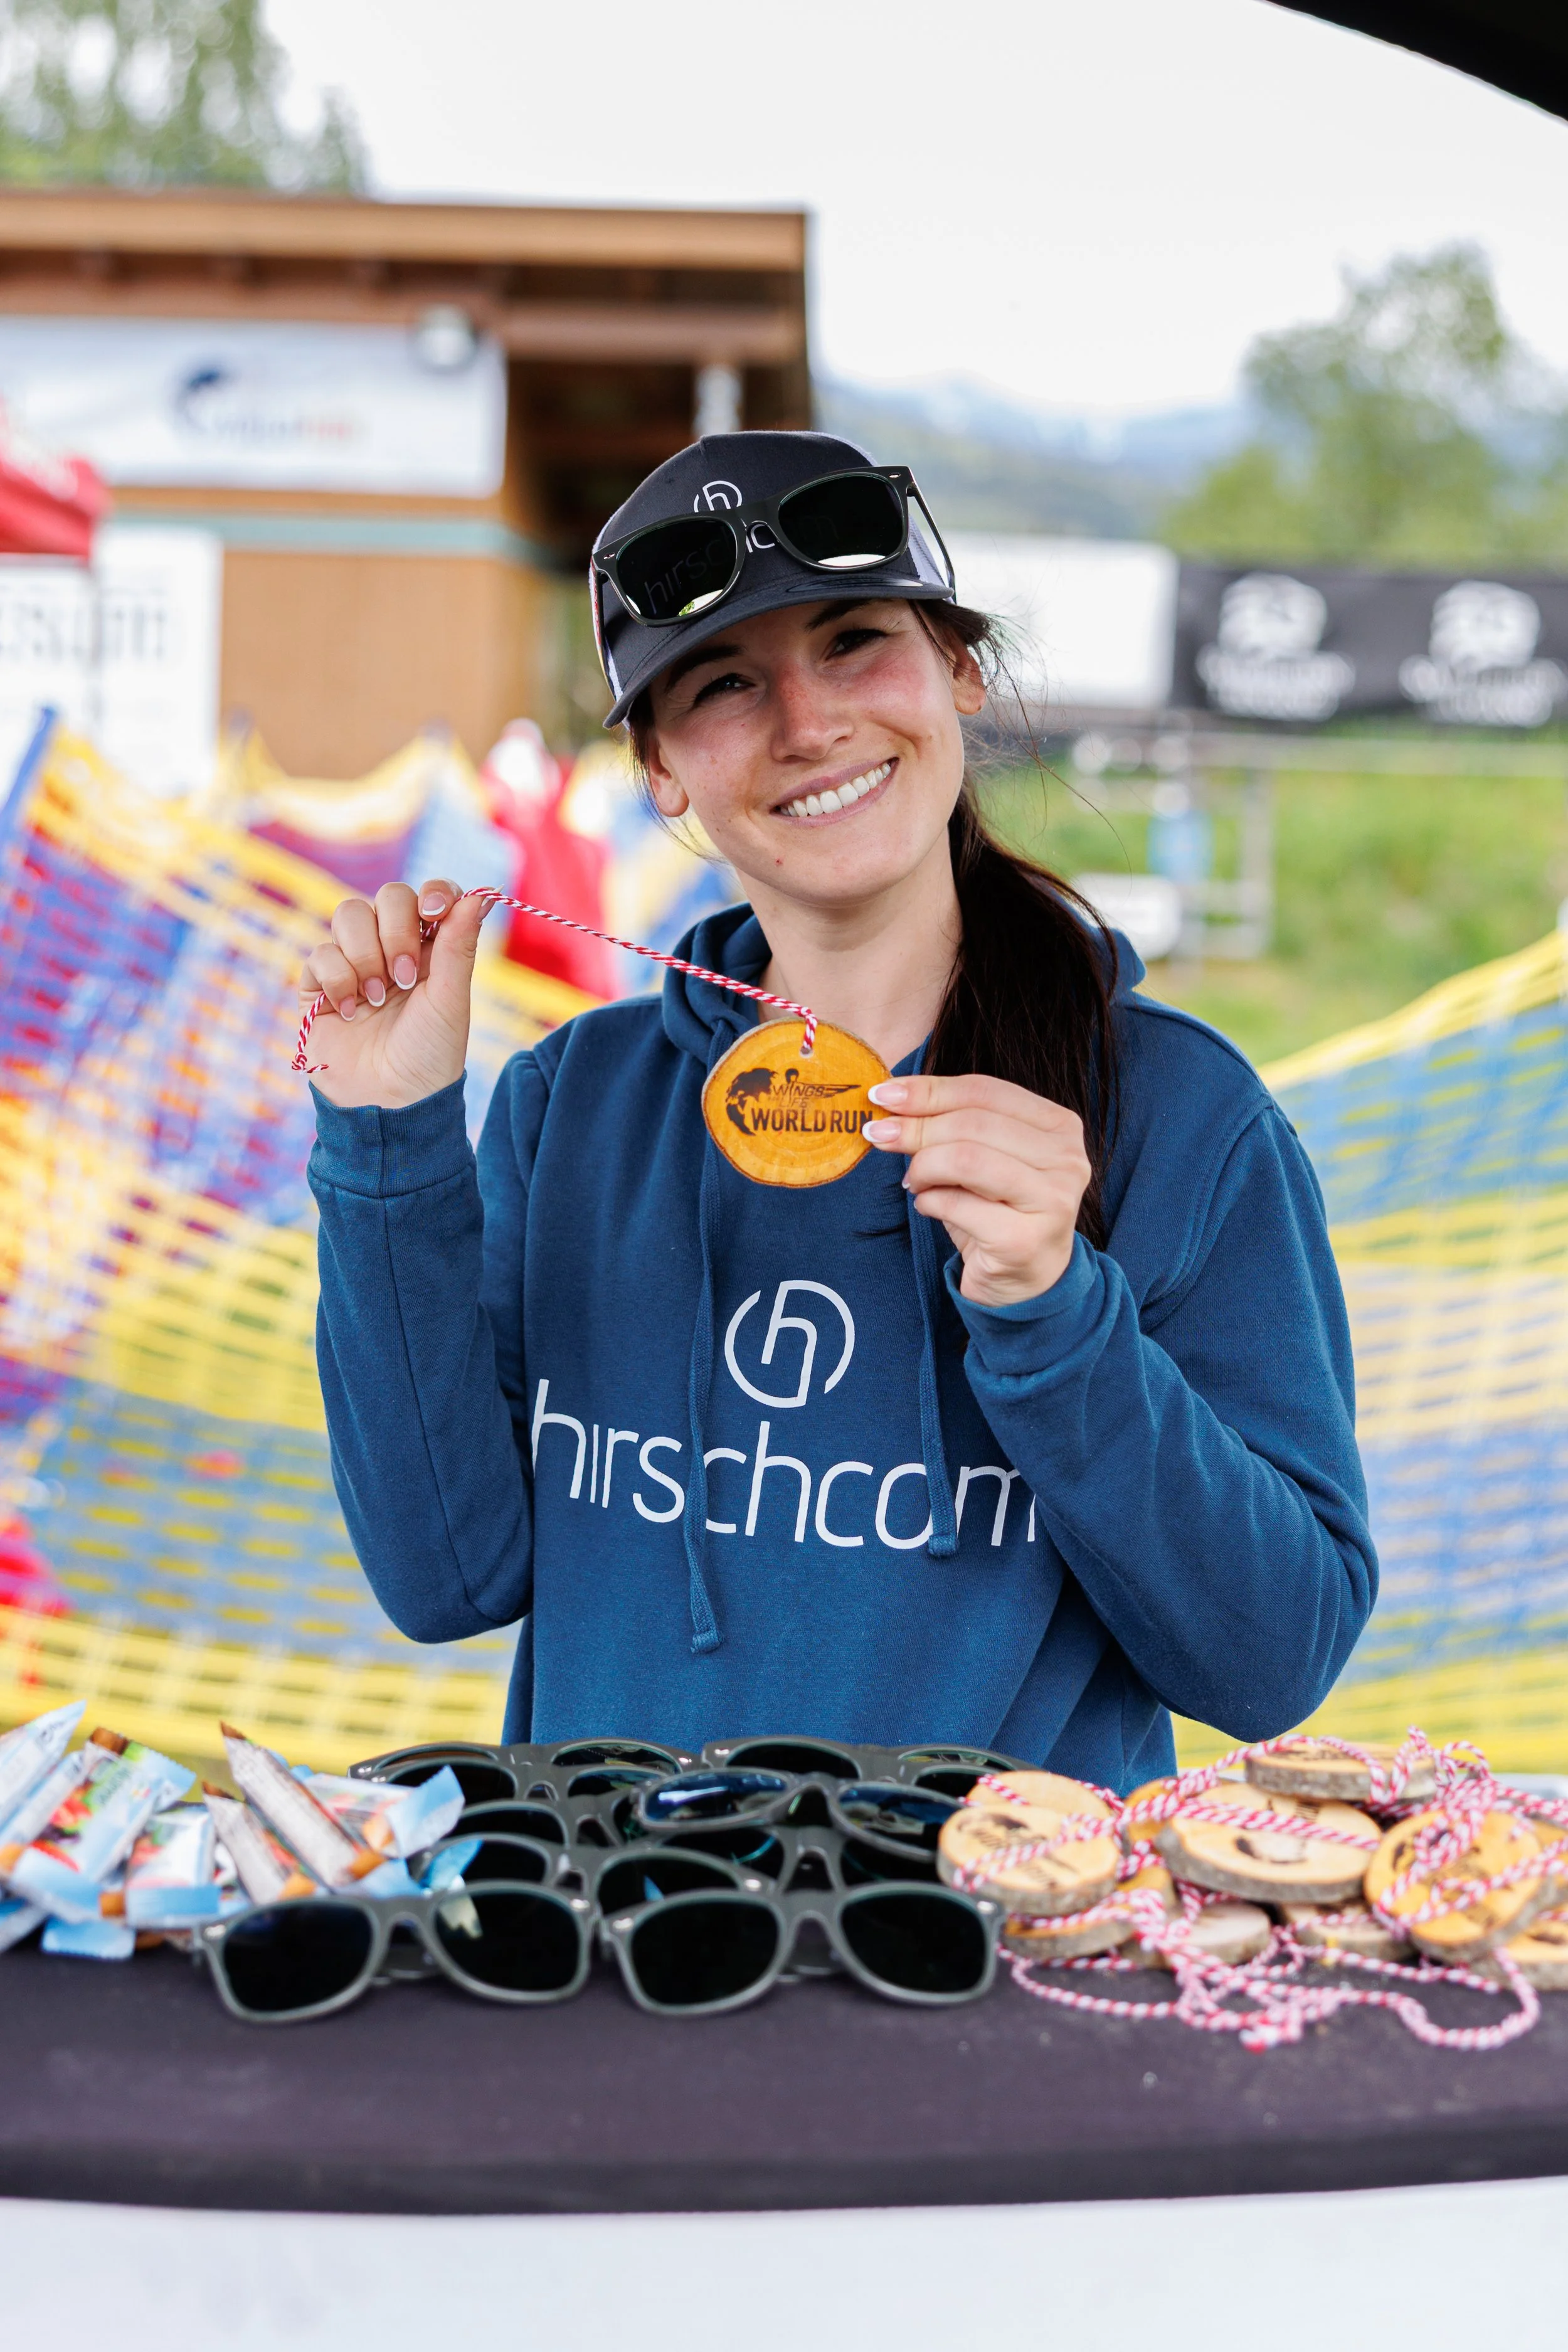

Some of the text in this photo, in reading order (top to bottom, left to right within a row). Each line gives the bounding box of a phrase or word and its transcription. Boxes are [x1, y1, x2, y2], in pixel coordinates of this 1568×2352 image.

[773, 1083, 826, 1097] WINGS
[751, 1108, 872, 1133] WORLD RUN
[532, 1379, 1035, 1550] hirschcom
